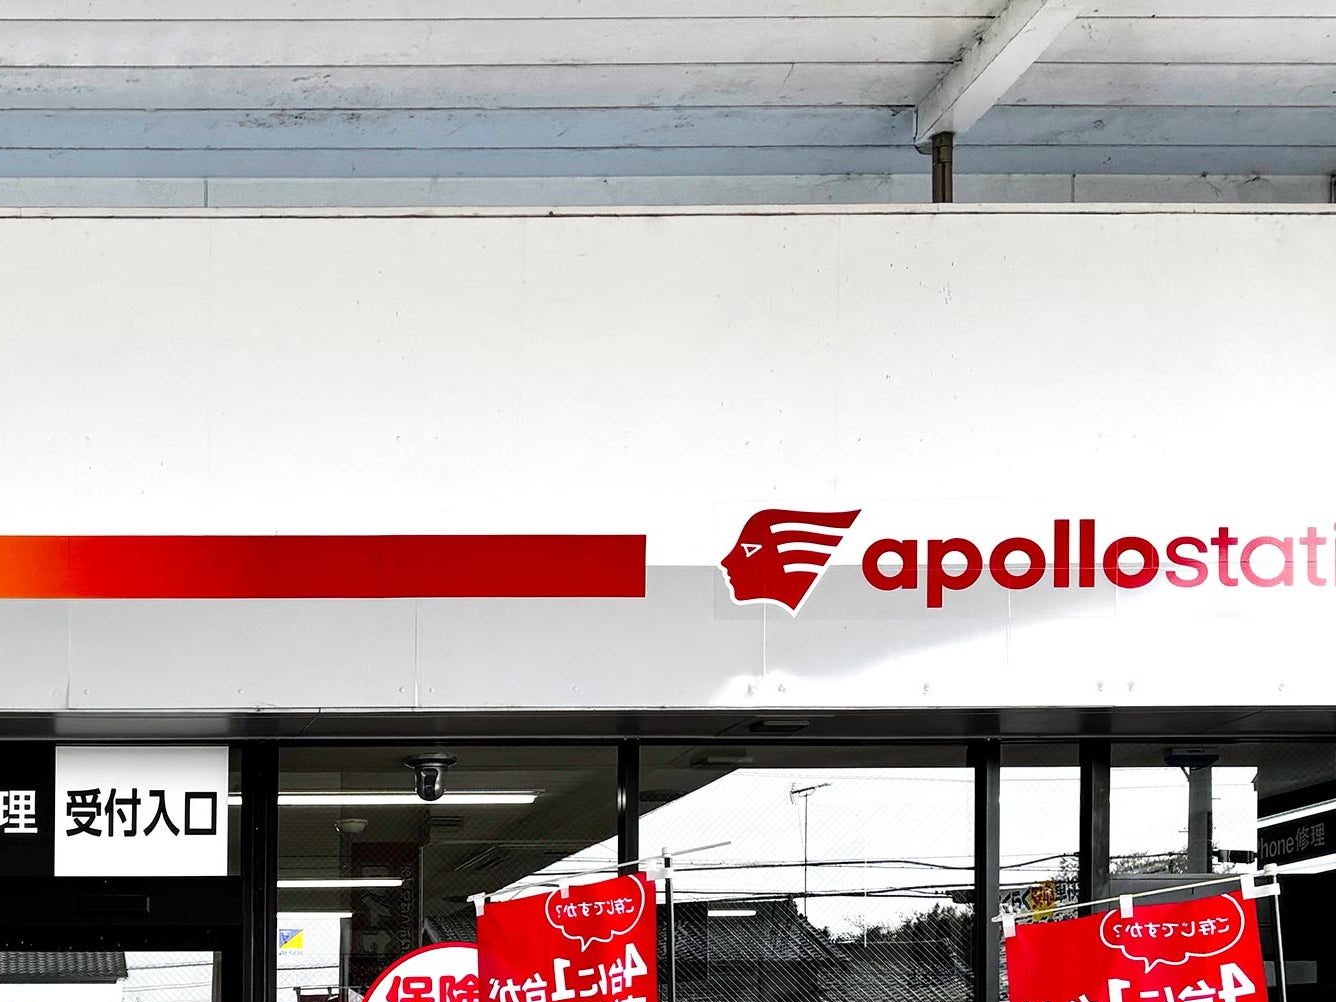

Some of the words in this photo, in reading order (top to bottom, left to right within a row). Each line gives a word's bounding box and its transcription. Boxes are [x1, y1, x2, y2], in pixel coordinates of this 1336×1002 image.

[65, 788, 218, 838] 受付入口
[1258, 822, 1326, 861] hone修理
